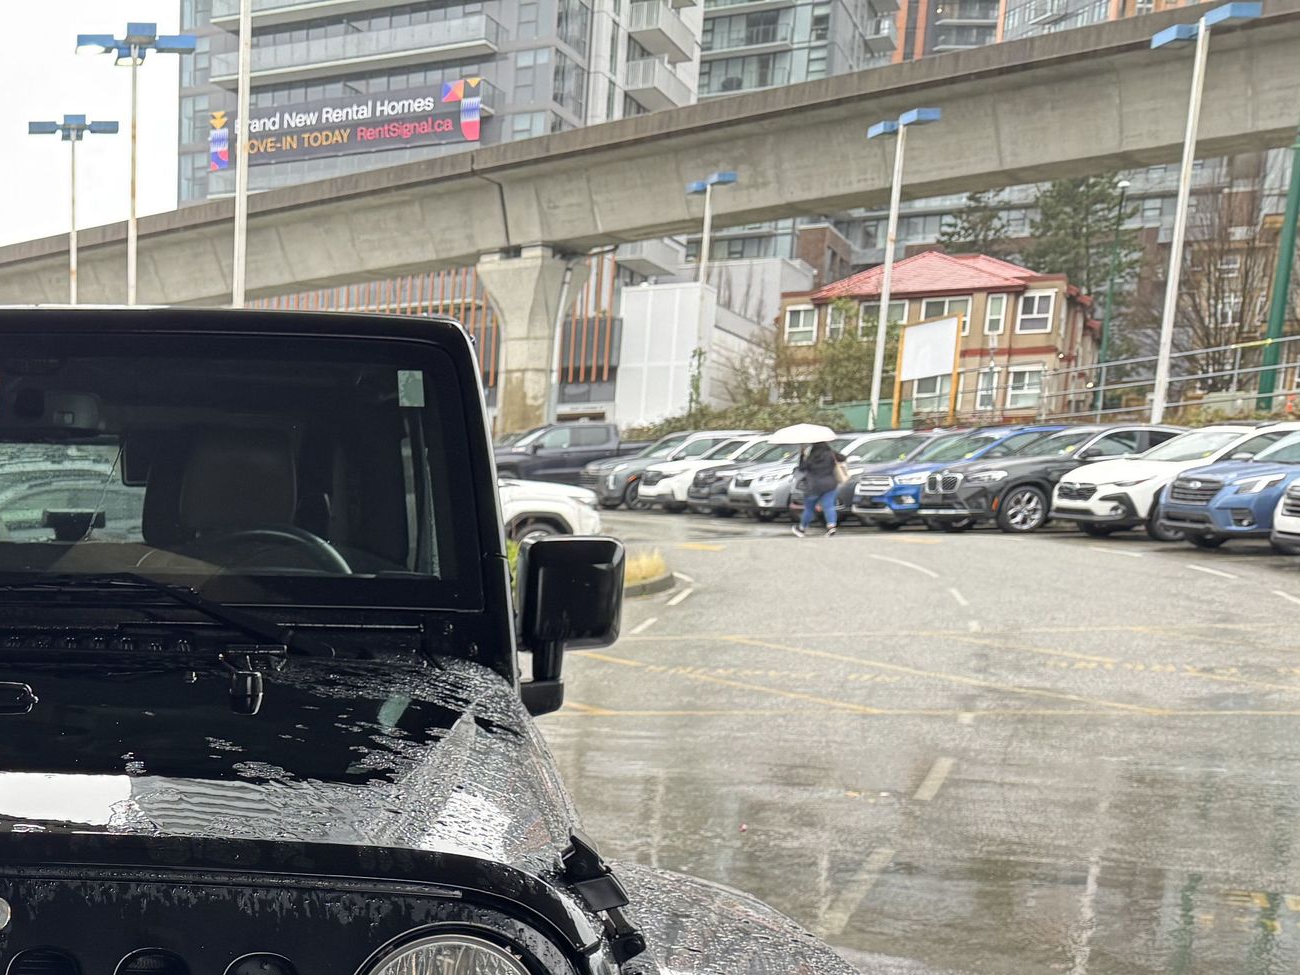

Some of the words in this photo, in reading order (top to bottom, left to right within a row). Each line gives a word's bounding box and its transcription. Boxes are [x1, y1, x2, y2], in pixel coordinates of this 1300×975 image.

[283, 111, 318, 129] New
[322, 100, 372, 124] Rental
[376, 96, 435, 117] Homes
[235, 135, 298, 155] OVE-IN
[301, 127, 351, 148] TODAY
[356, 116, 454, 141] RentSignal.ca
